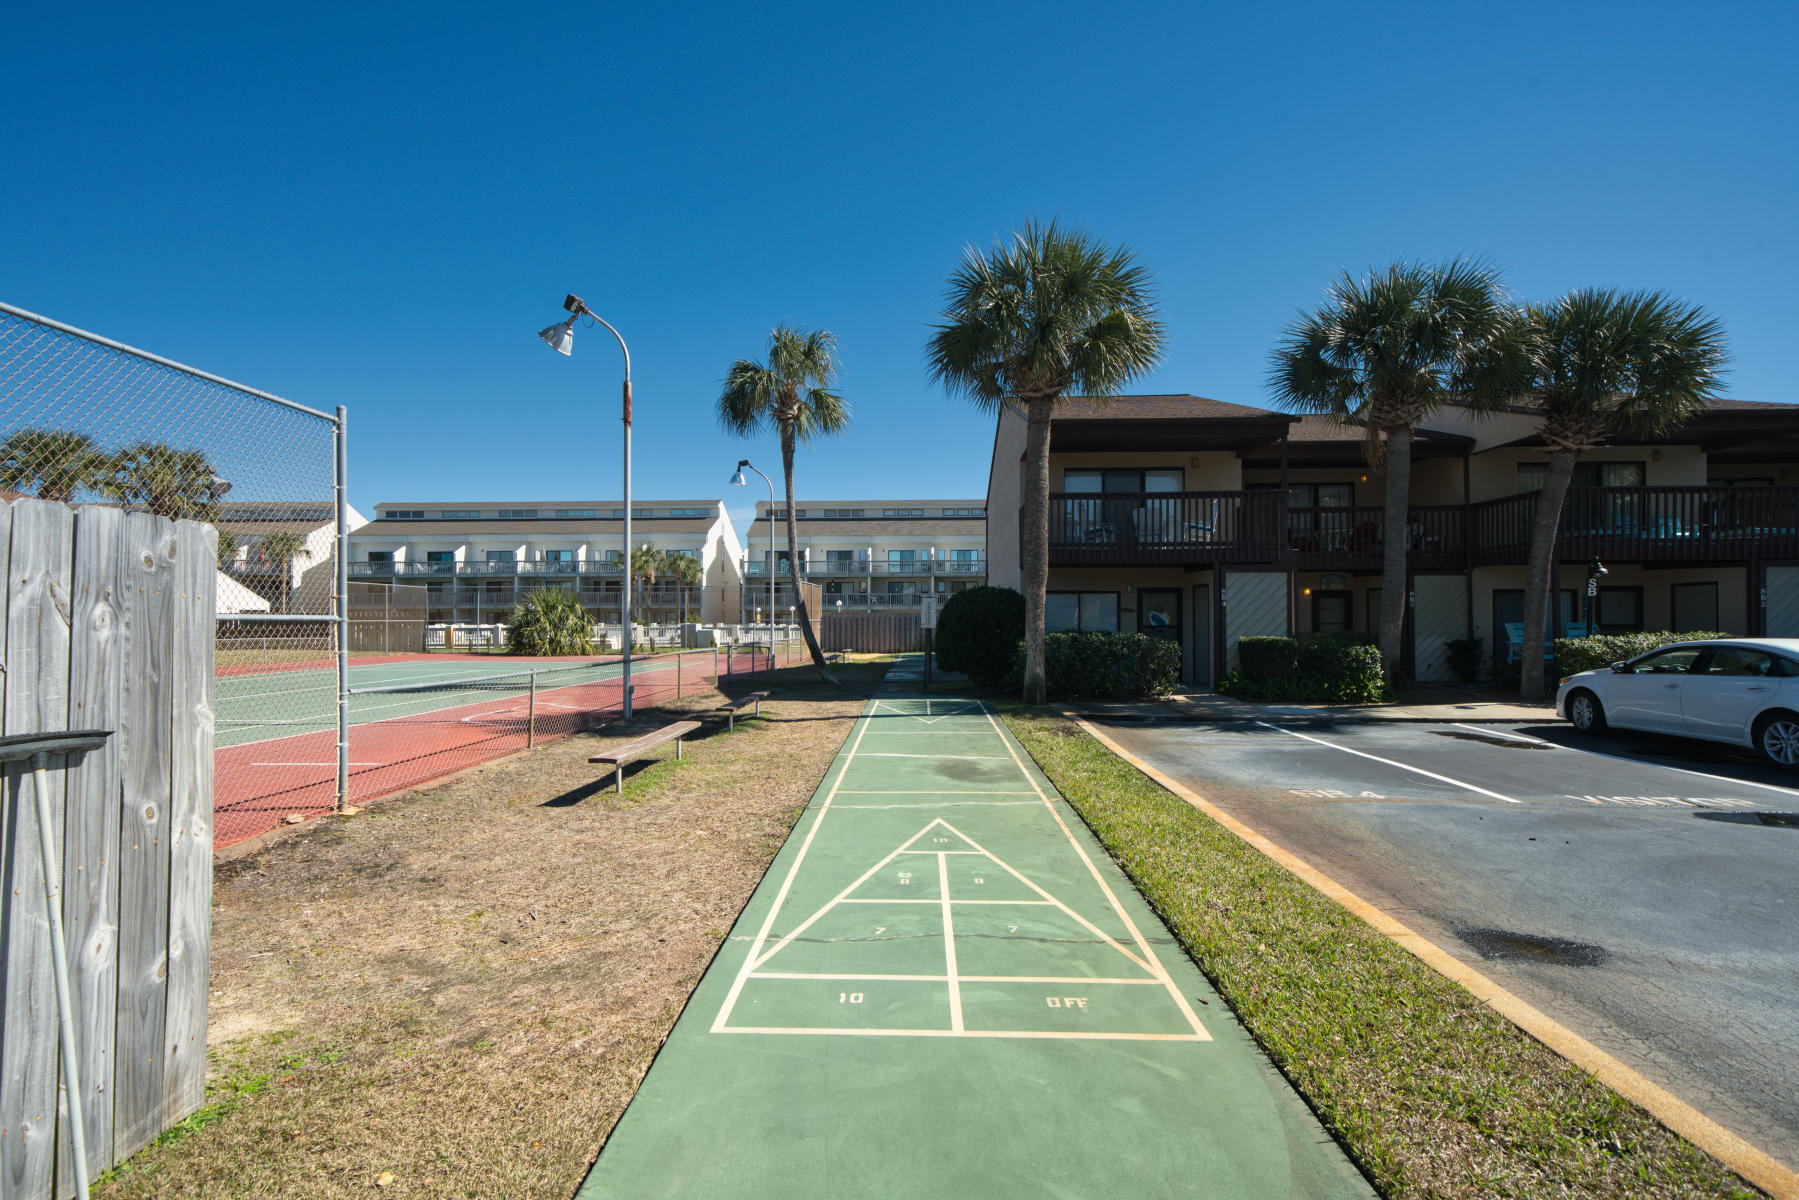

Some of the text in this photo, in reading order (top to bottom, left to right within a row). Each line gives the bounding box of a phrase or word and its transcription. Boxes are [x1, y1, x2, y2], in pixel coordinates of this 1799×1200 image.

[1587, 577, 1598, 597] SB
[875, 926, 886, 935] 7
[1007, 925, 1018, 933] 7
[839, 992, 864, 1003] 10
[1046, 996, 1088, 1008] OFF
